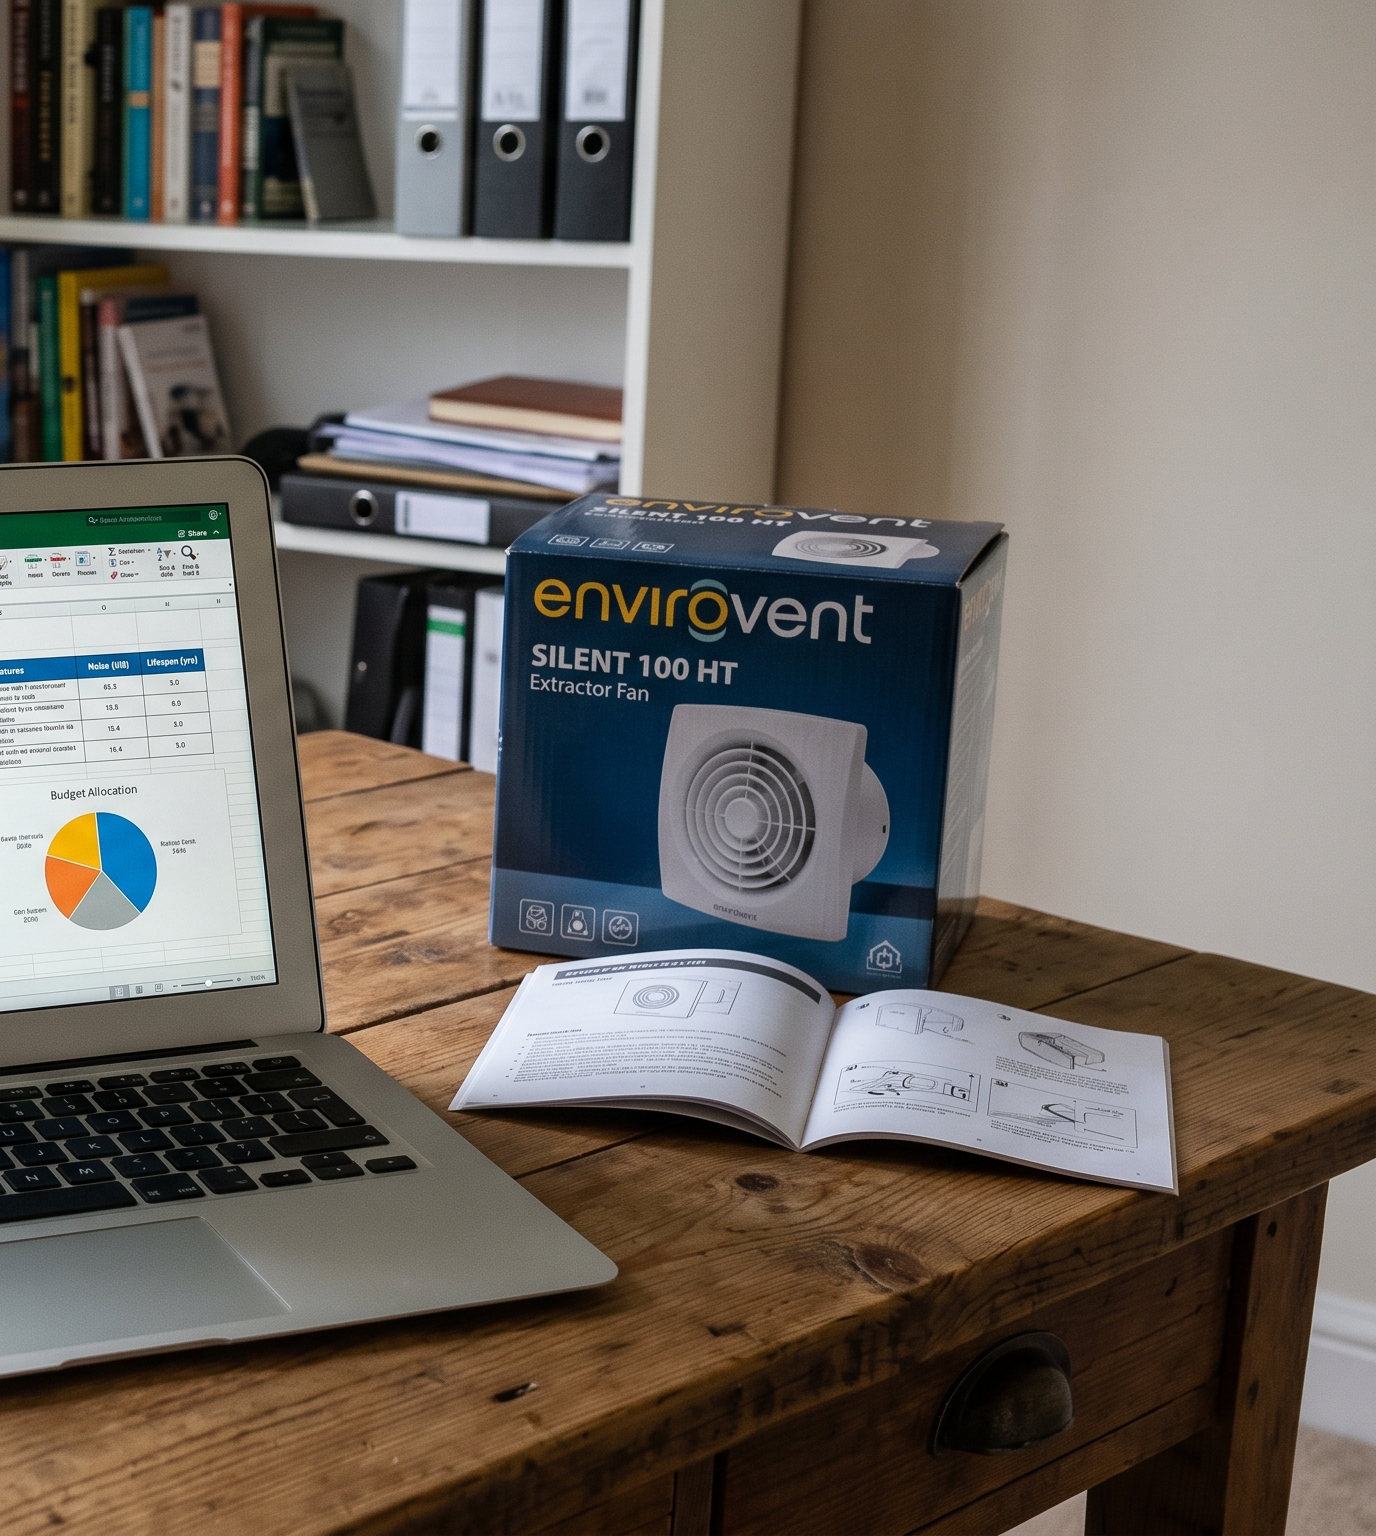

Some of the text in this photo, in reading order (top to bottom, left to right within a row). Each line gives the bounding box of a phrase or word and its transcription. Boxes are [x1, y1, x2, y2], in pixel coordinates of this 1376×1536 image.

[696, 513, 744, 524] 100
[534, 579, 874, 645] envirovent
[531, 643, 739, 685] SILENT 100 HT
[529, 674, 650, 702] Extractor Fan
[51, 785, 138, 801] Budget Allocation
[107, 1117, 119, 1125] O
[88, 1142, 101, 1150] K
[78, 1167, 94, 1175] M
[25, 1173, 39, 1182] N
